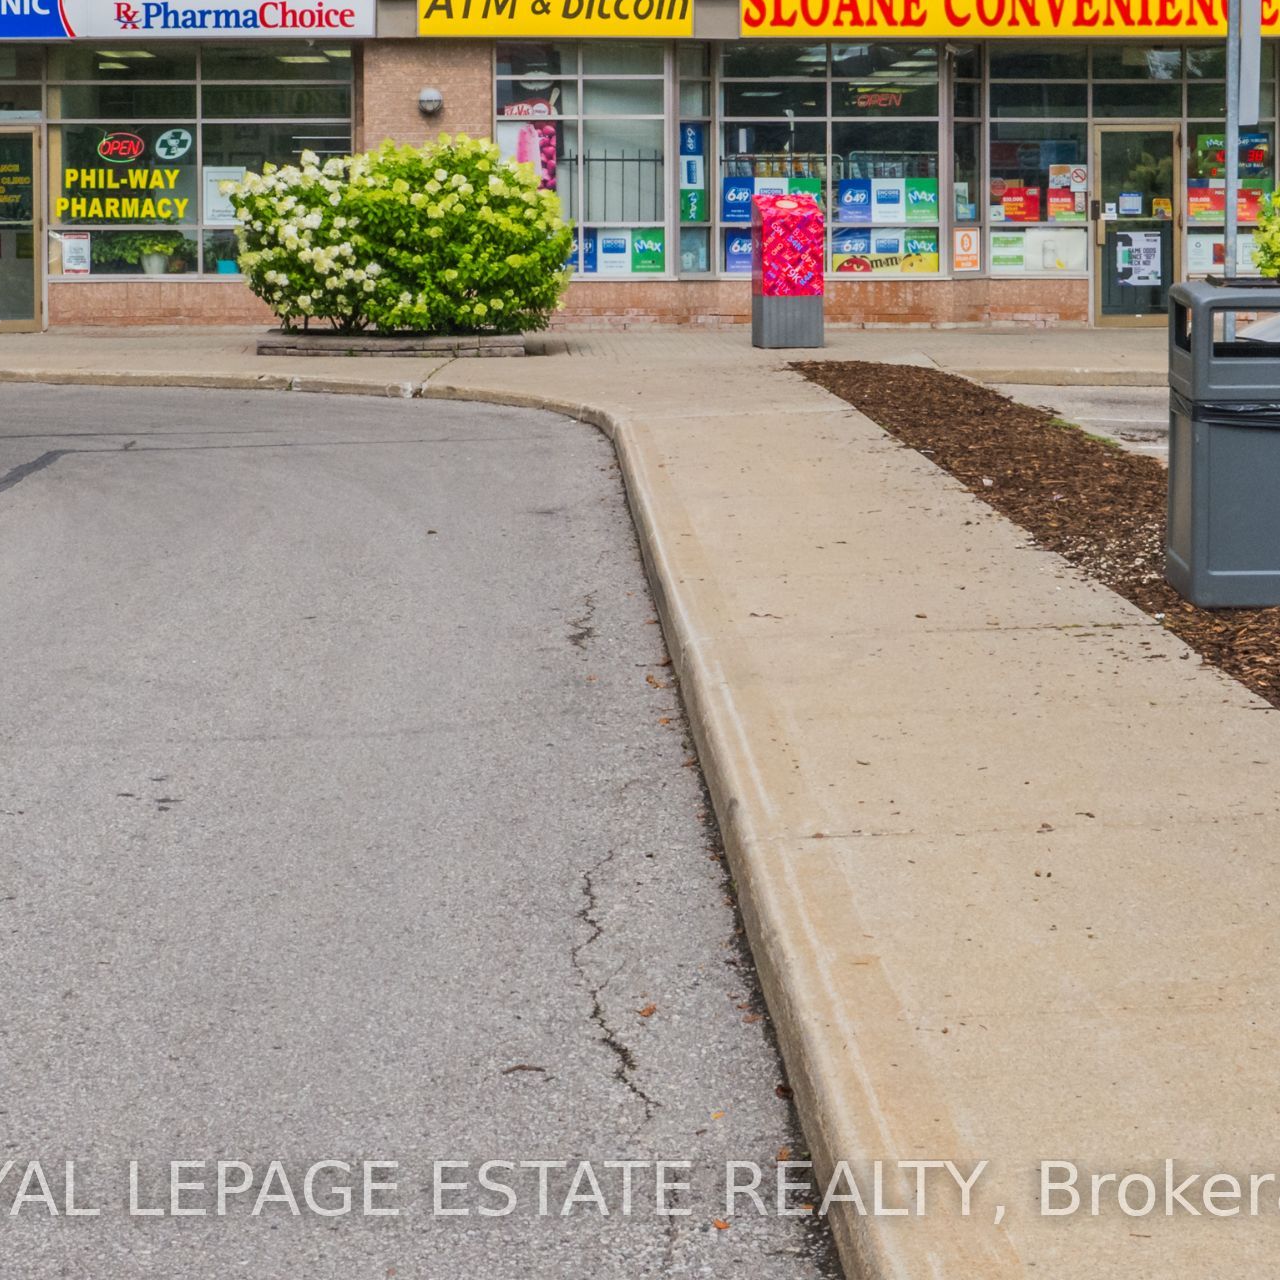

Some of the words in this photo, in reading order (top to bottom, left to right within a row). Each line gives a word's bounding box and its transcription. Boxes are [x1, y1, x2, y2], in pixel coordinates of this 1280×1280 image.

[142, 1, 355, 29] PharmaChoice
[856, 92, 903, 108] OPEN
[100, 140, 140, 155] OPEN
[64, 168, 180, 189] PHIL-WAY
[727, 188, 749, 201] 649
[843, 190, 866, 203] 649
[907, 190, 935, 204] MAX
[55, 197, 189, 219] PHARMACY
[633, 239, 662, 253] MAX
[843, 239, 866, 252] 649
[907, 239, 935, 253] MAX
